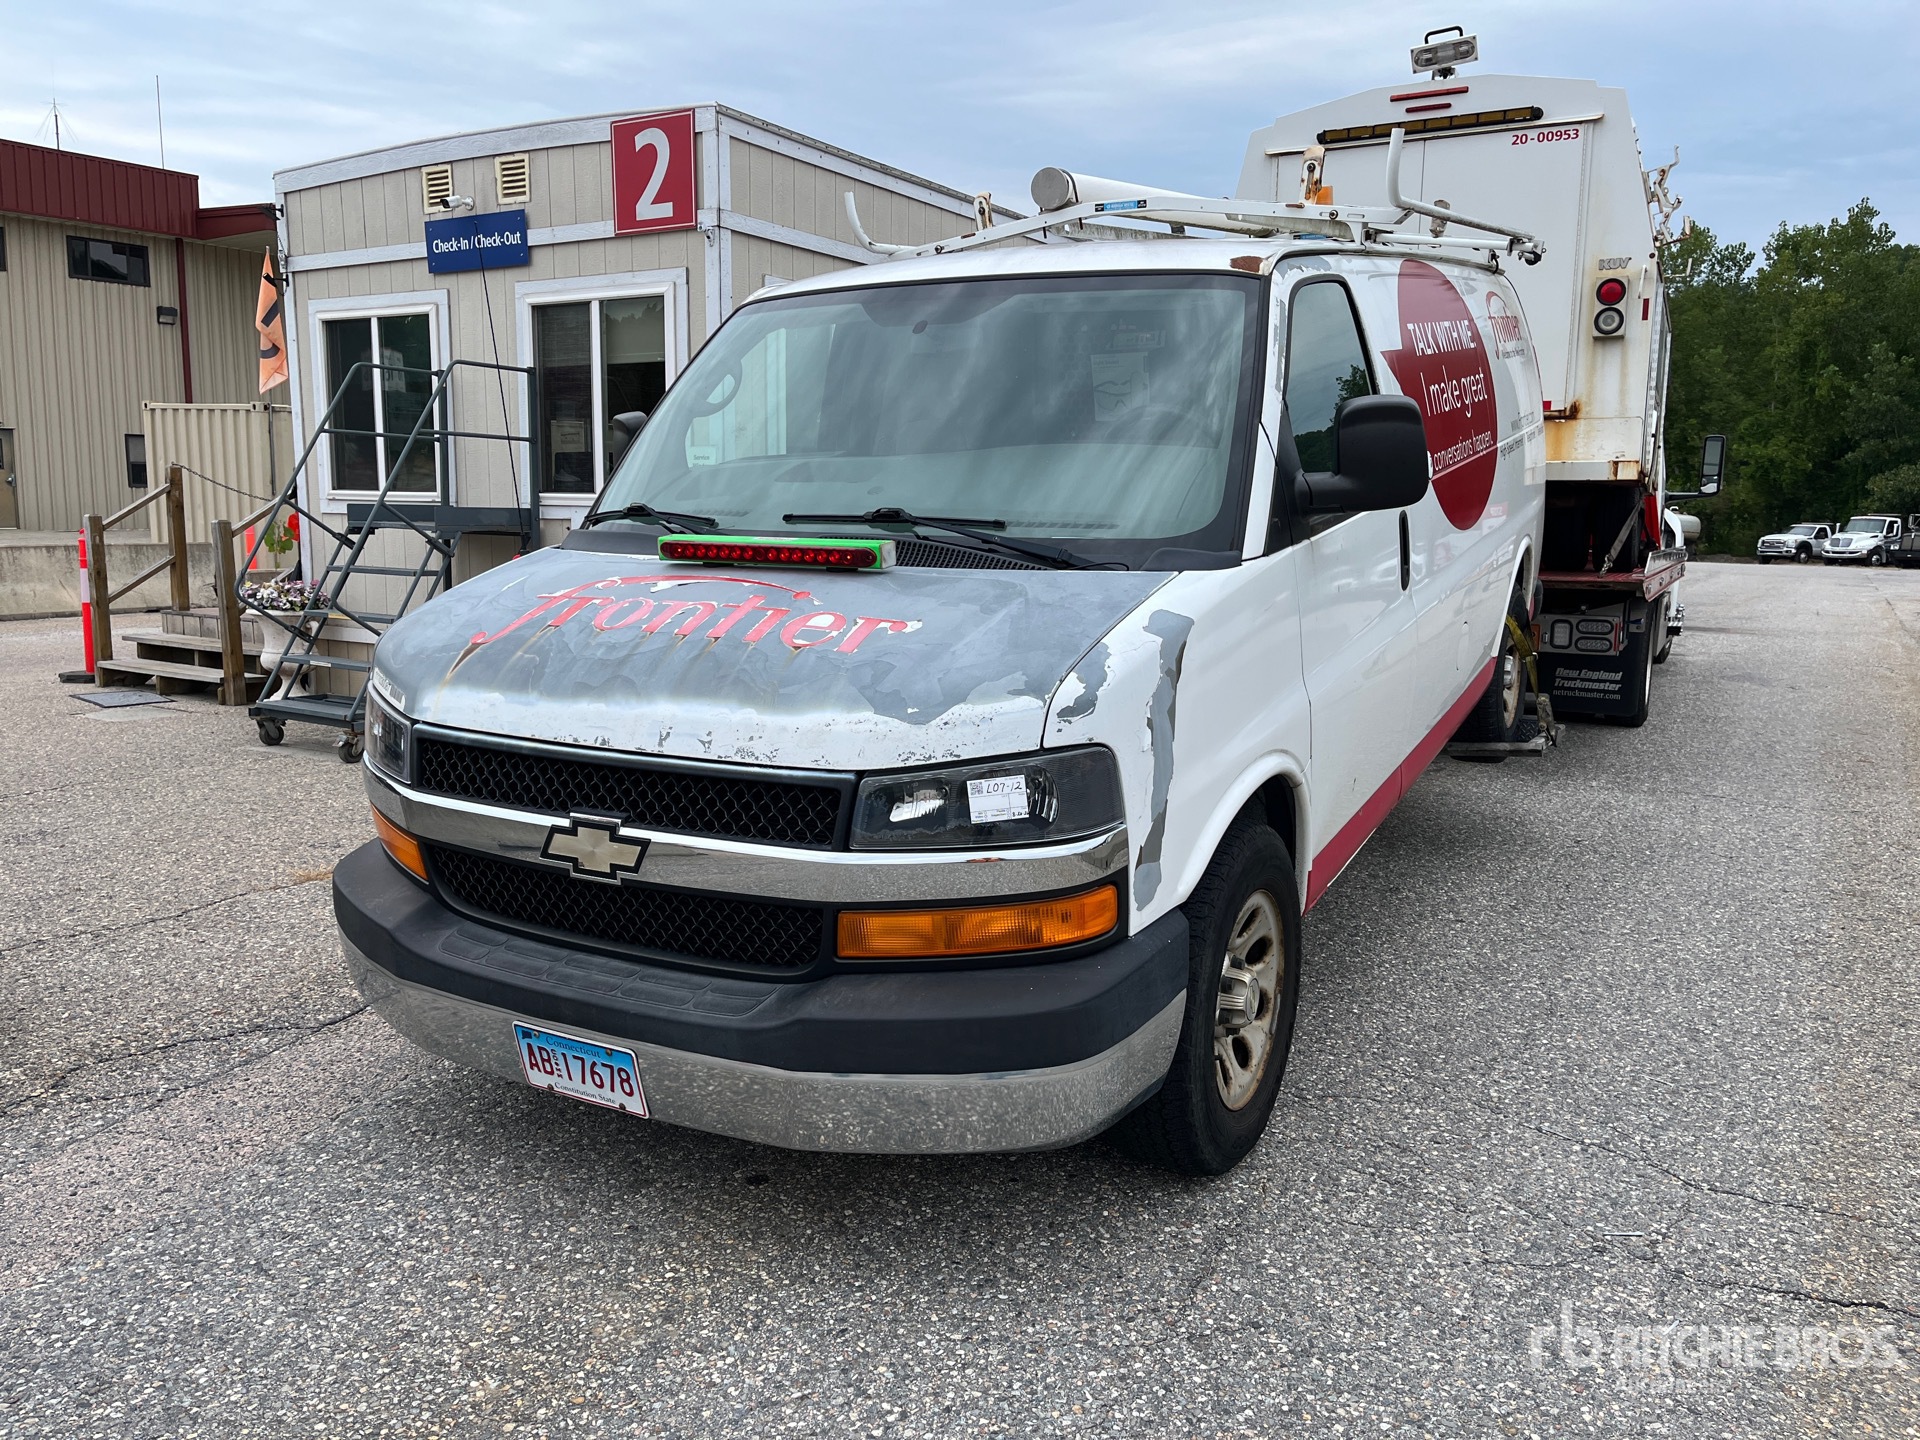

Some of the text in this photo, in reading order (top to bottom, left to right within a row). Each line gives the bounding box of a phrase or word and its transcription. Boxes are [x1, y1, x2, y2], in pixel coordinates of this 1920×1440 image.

[634, 127, 673, 221] 2
[432, 235, 469, 253] Check-In
[474, 231, 522, 249] Check-Out
[1598, 256, 1632, 271] KUV
[1406, 322, 1438, 356] TALK
[1432, 320, 1461, 353] WITH
[1420, 365, 1488, 418] I make great
[1433, 436, 1473, 471] conversations
[470, 575, 912, 654] frontier
[1554, 678, 1622, 691] Truckmaster
[1555, 667, 1623, 681] New England
[1552, 689, 1621, 701] netruckmaster.com
[545, 1035, 601, 1059] Connecticut
[554, 1081, 617, 1105] Constitution State
